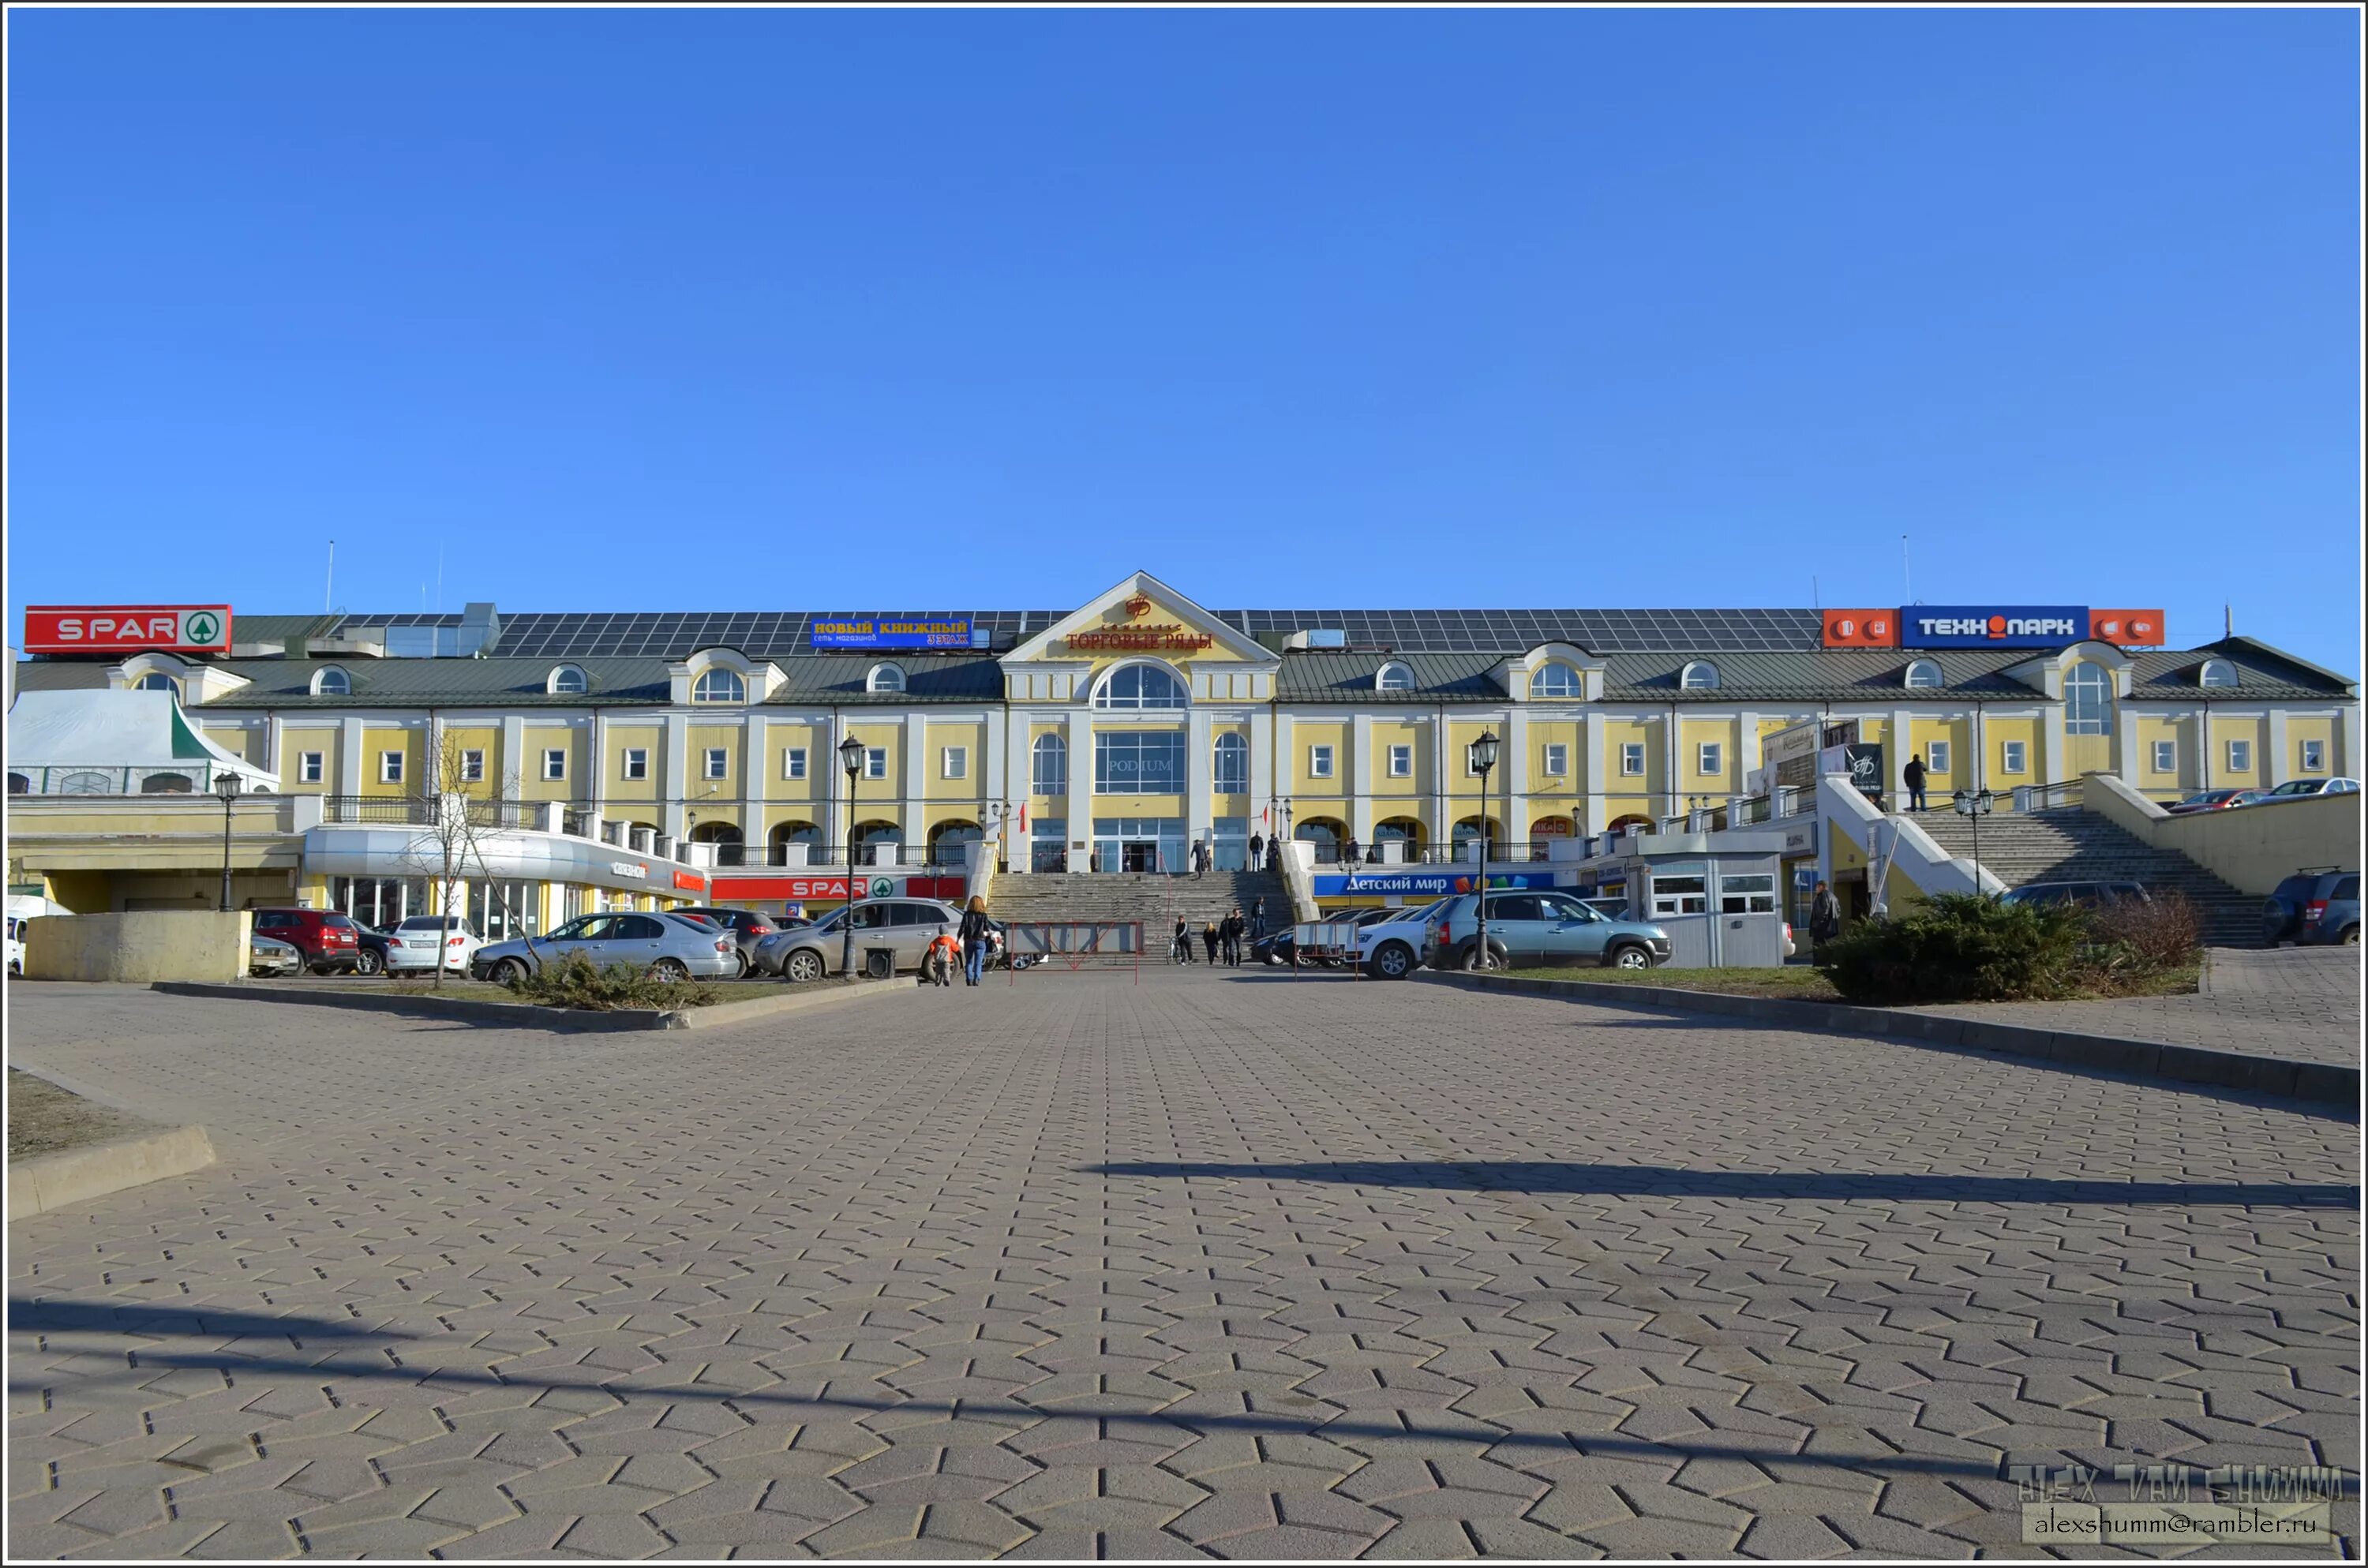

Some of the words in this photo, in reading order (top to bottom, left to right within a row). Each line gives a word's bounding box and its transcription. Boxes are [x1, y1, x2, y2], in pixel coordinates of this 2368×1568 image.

[58, 618, 175, 640] SPAR
[814, 620, 874, 634] НОВЫЙ
[879, 620, 968, 634] КНИЖНЫЙ
[1918, 616, 2074, 638] ТЕХНОПАРК
[927, 634, 935, 645] 3
[936, 634, 969, 645] ЭТАЖ
[1066, 634, 1160, 650] ТОРГОВЫЕ
[1166, 634, 1213, 650] РЯДЫ
[1109, 760, 1171, 772] PODIUM
[792, 881, 866, 896] SPAR
[1347, 876, 1411, 891] Детский
[1415, 878, 1447, 893] мир
